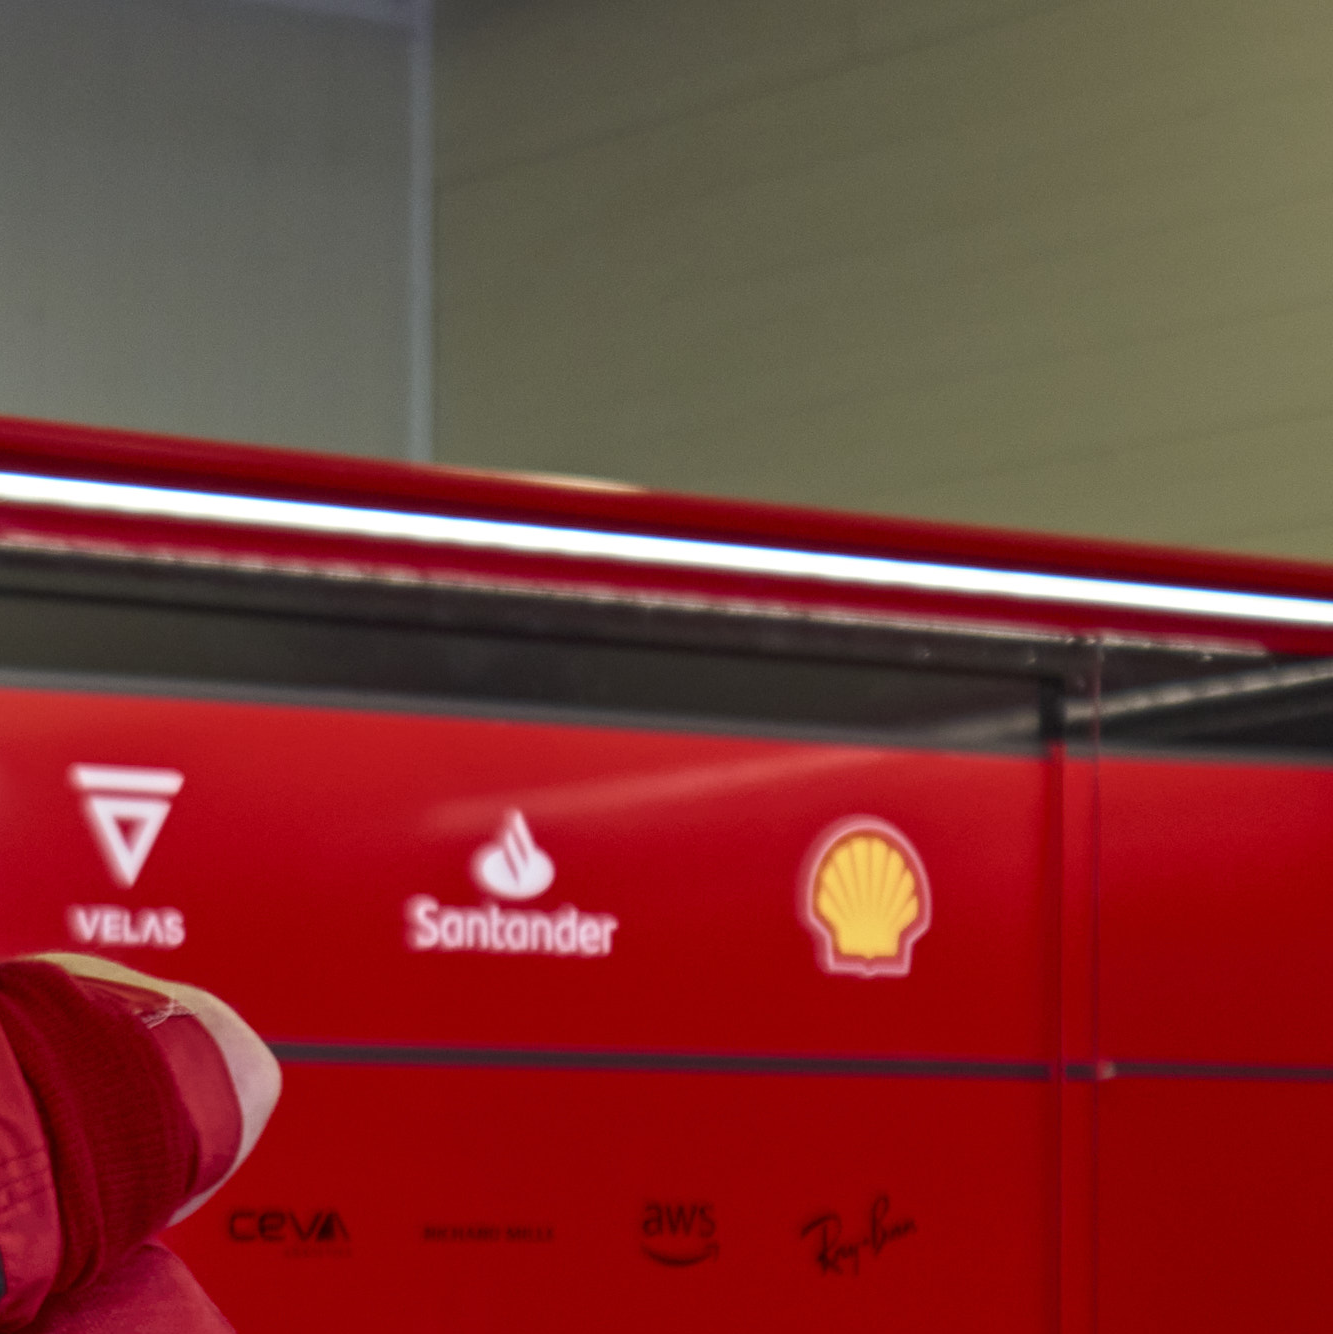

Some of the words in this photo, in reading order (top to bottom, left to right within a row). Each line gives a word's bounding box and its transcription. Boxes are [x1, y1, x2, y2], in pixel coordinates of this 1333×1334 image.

[74, 906, 185, 948] VELAS
[411, 898, 617, 956] Santander
[641, 1202, 717, 1238] aws
